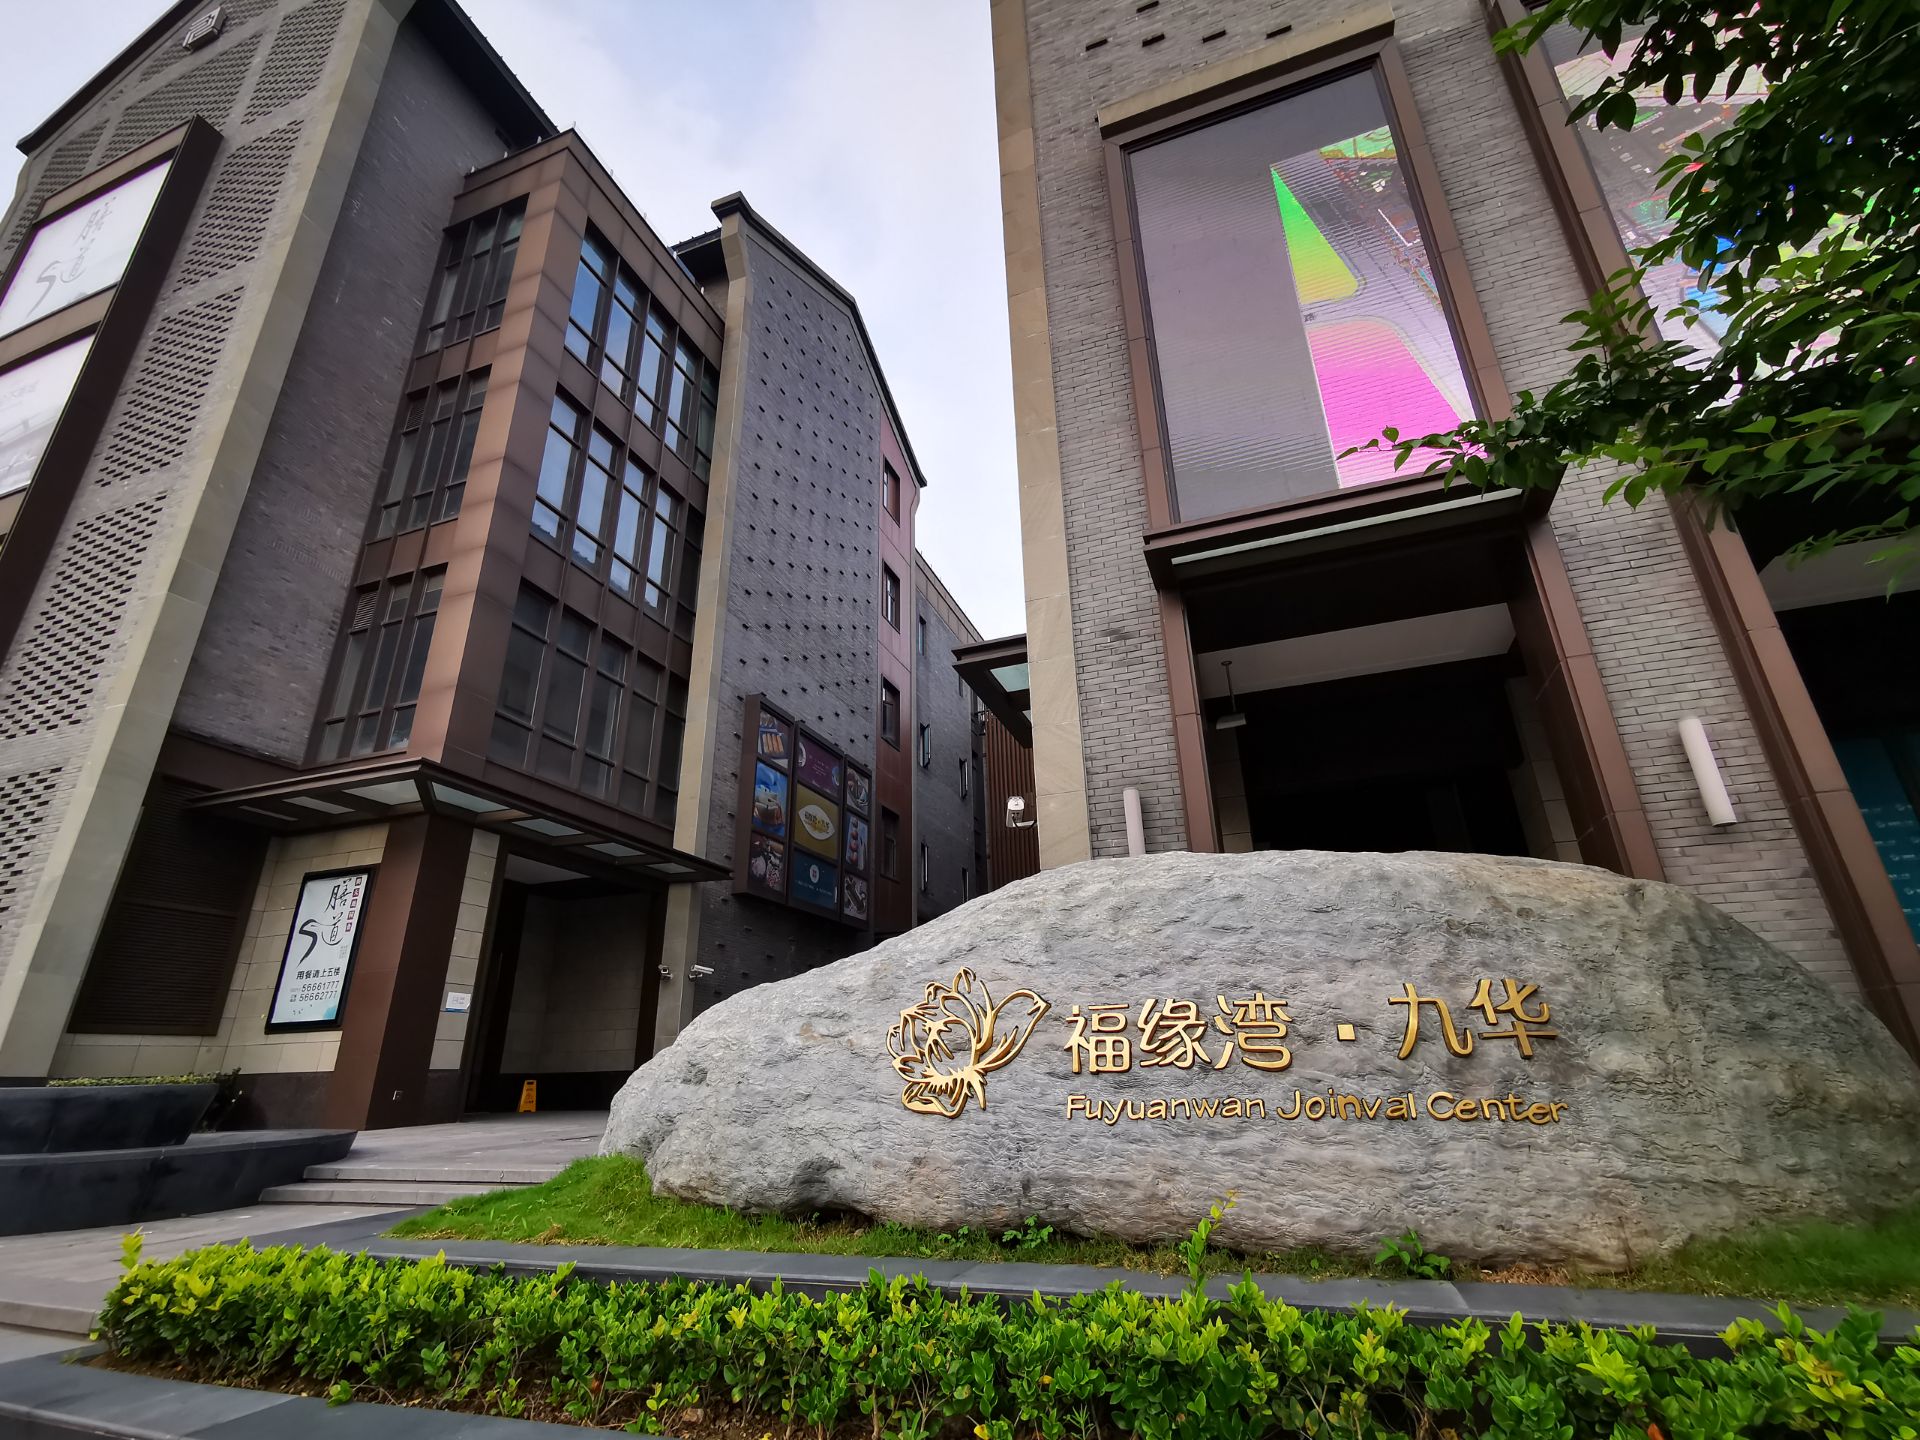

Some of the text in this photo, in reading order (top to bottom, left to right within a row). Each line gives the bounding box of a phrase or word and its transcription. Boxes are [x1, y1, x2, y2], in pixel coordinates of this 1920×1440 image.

[1066, 1088, 1568, 1126] Fuyuanwan Joinval Center
